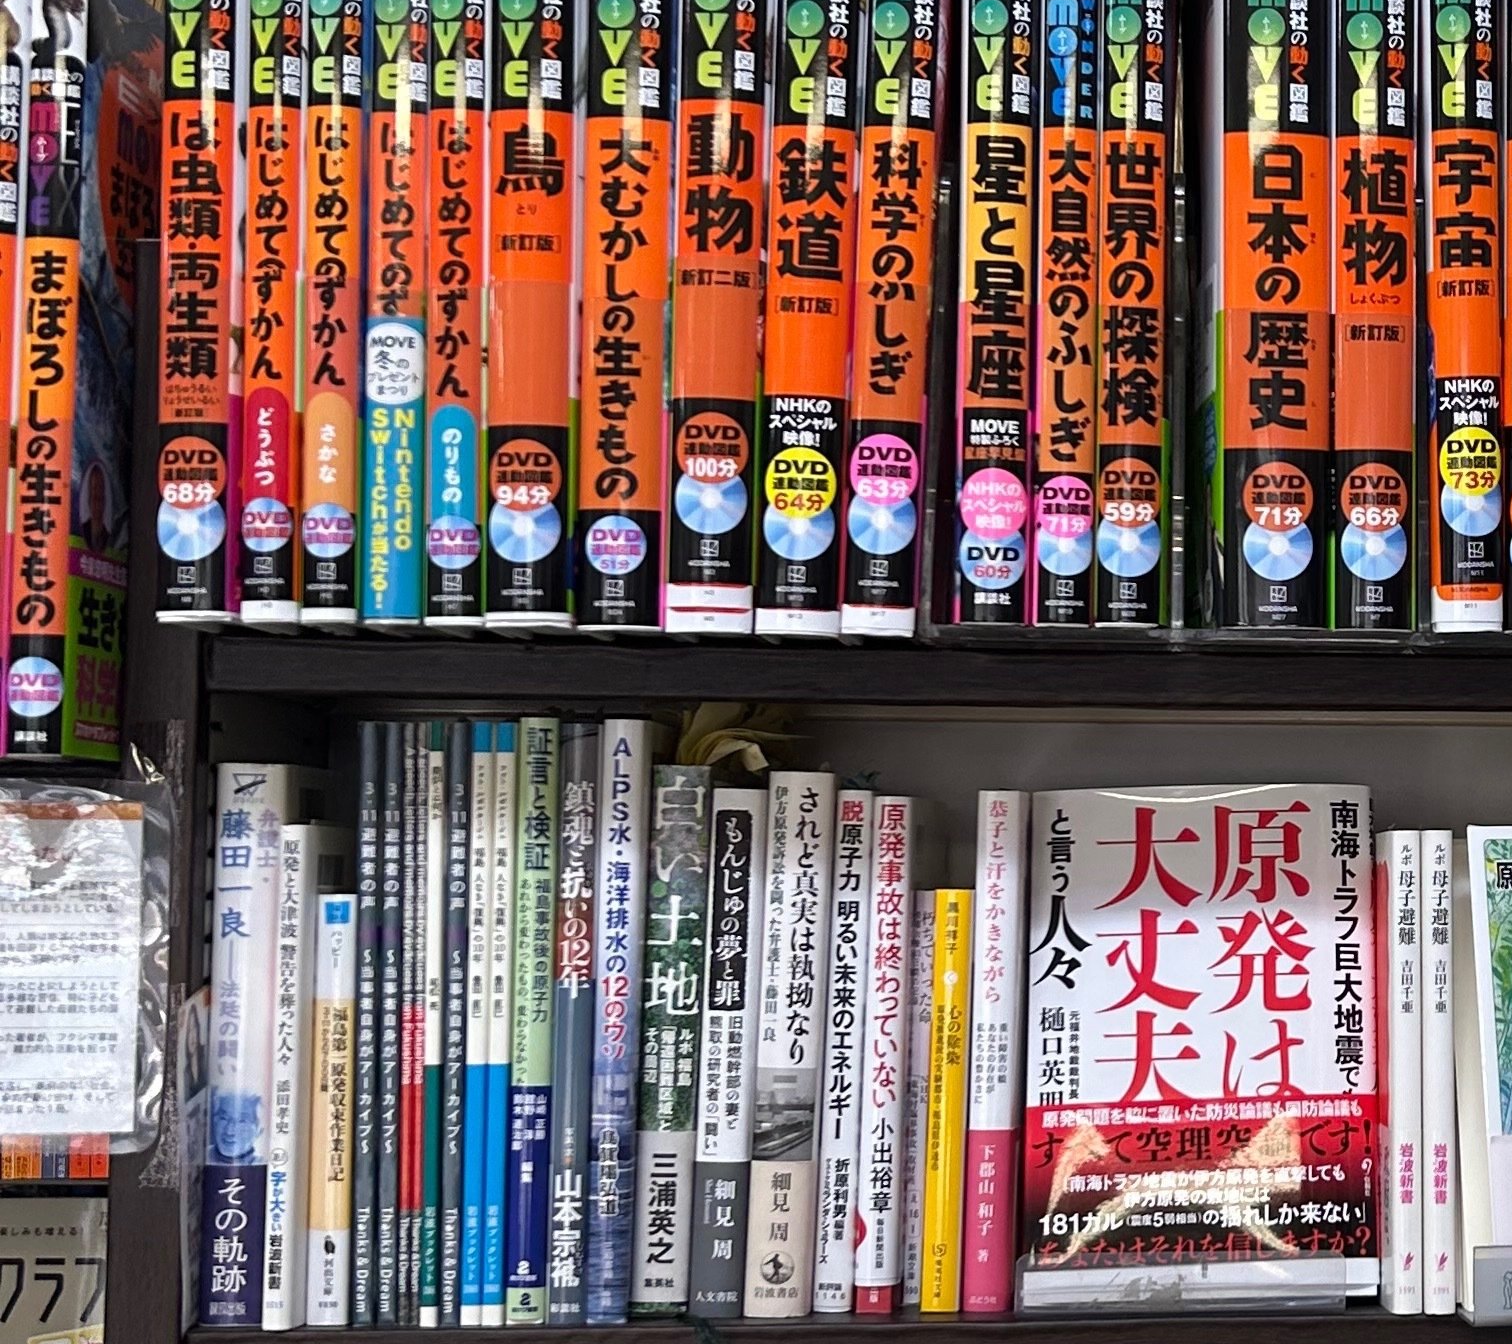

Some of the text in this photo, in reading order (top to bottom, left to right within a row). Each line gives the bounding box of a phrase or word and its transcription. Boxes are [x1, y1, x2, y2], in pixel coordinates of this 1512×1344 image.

[495, 123, 565, 197] 鳥
[686, 112, 756, 255] 動物
[776, 137, 848, 284] 鉄道
[1341, 150, 1408, 287] 植物
[1434, 138, 1497, 270] 宇宙
[593, 130, 650, 501] 大むかしの生きもの
[868, 139, 922, 396] 科学のふしぎ
[968, 134, 1028, 401] 星と星座
[1044, 140, 1092, 463] 大自然のふしぎ
[1102, 141, 1161, 427] 世界の探検
[1244, 143, 1309, 431] 日本の歴史
[17, 249, 68, 627] まぼろしの生きもの
[254, 406, 276, 485] どうぶつ
[525, 728, 554, 872] 証言と検証
[715, 816, 746, 1009] もんじゅの夢と罪
[872, 802, 907, 1110] 原発事故は終わっていない
[1029, 808, 1093, 990] と言う人々
[210, 1177, 248, 1295] その軌跡
[645, 1151, 680, 1266] 三浦英之
